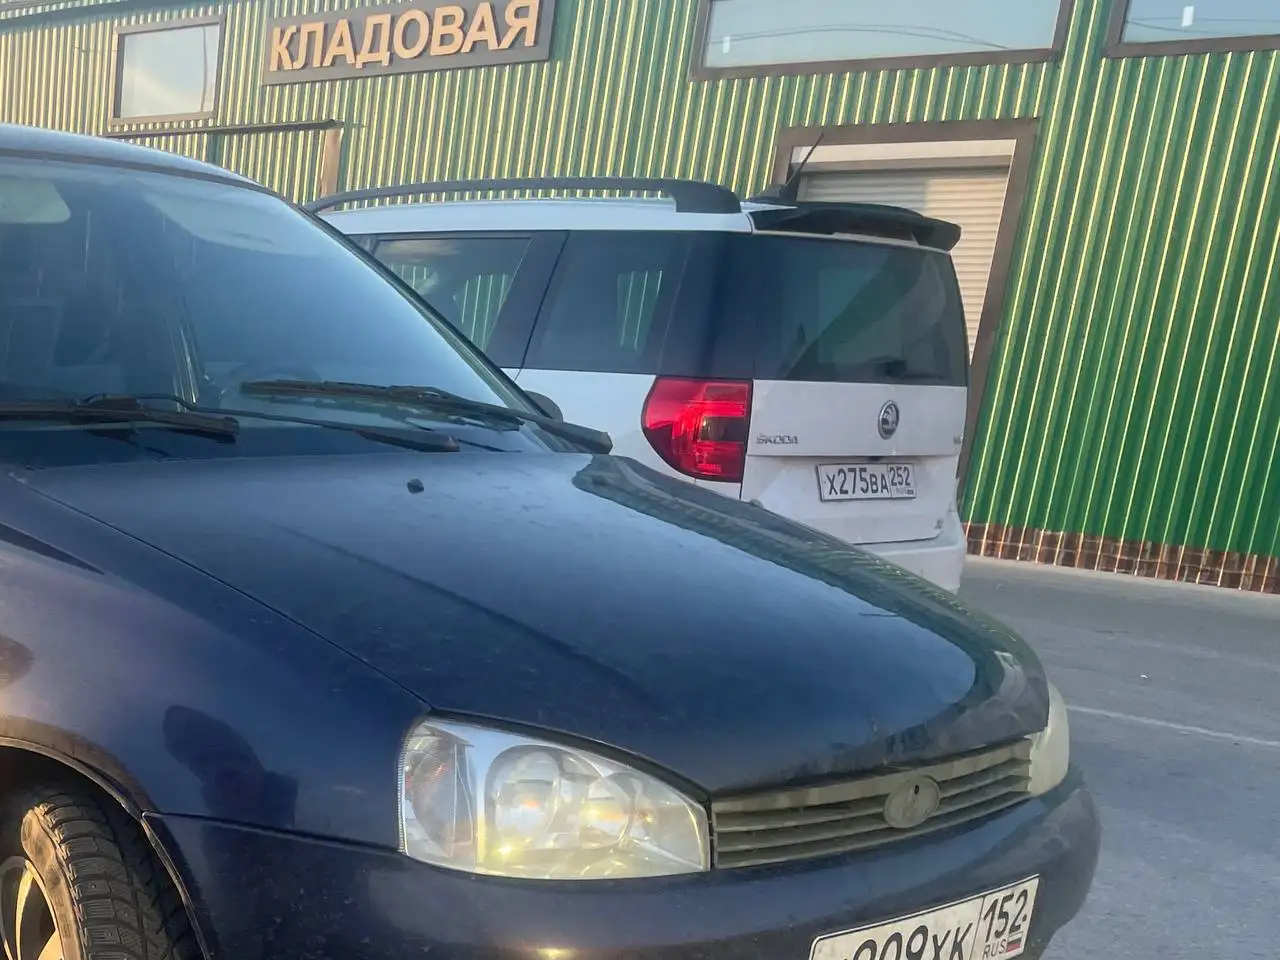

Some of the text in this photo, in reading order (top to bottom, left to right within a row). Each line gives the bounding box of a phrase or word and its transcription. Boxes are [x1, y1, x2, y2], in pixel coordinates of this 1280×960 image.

[269, 0, 540, 72] КЛАДОВАЯ
[889, 466, 911, 487] 252
[983, 888, 1028, 943] 152
[982, 938, 1007, 960] RUS
